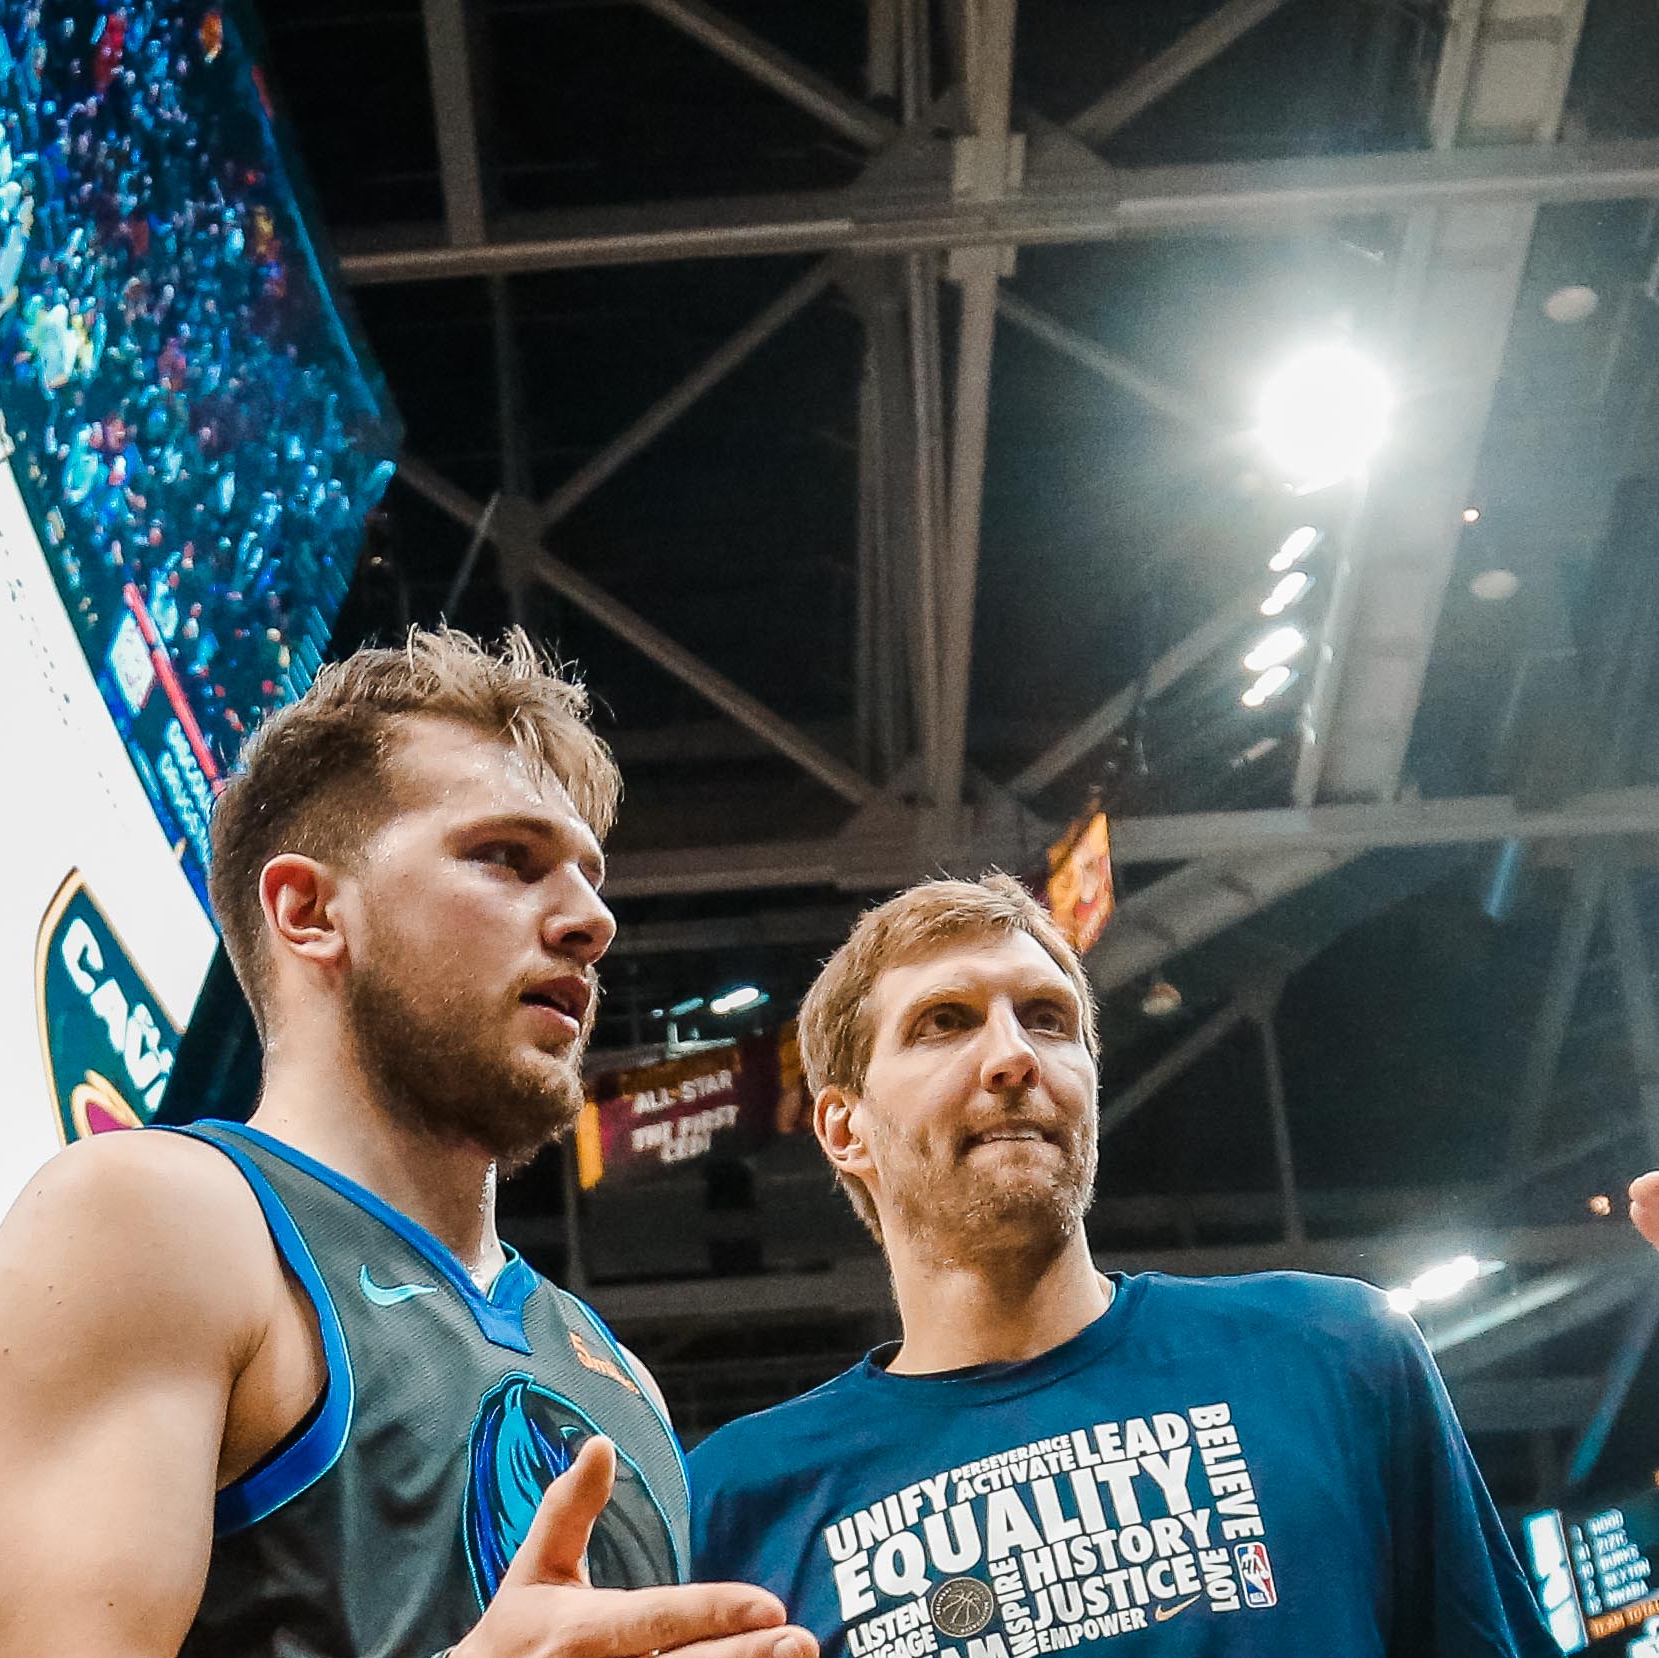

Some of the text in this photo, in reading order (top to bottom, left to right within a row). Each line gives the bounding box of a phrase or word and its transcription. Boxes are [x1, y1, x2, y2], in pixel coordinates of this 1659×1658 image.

[951, 1434, 1071, 1483] PERSEVERANCE
[1072, 1412, 1190, 1469] LEAD
[1189, 1402, 1265, 1541] BELIEVE
[955, 1450, 1076, 1503] ACTIVATE
[824, 1472, 954, 1561] UNIFY
[832, 1447, 1196, 1622] EQUALITY
[1021, 1509, 1212, 1592] HISTORY
[1197, 1547, 1241, 1613] LOVE
[1034, 1551, 1202, 1633] JUSTICE
[846, 1598, 932, 1658] LISTEN
[1037, 1607, 1148, 1654] EMPOWER
